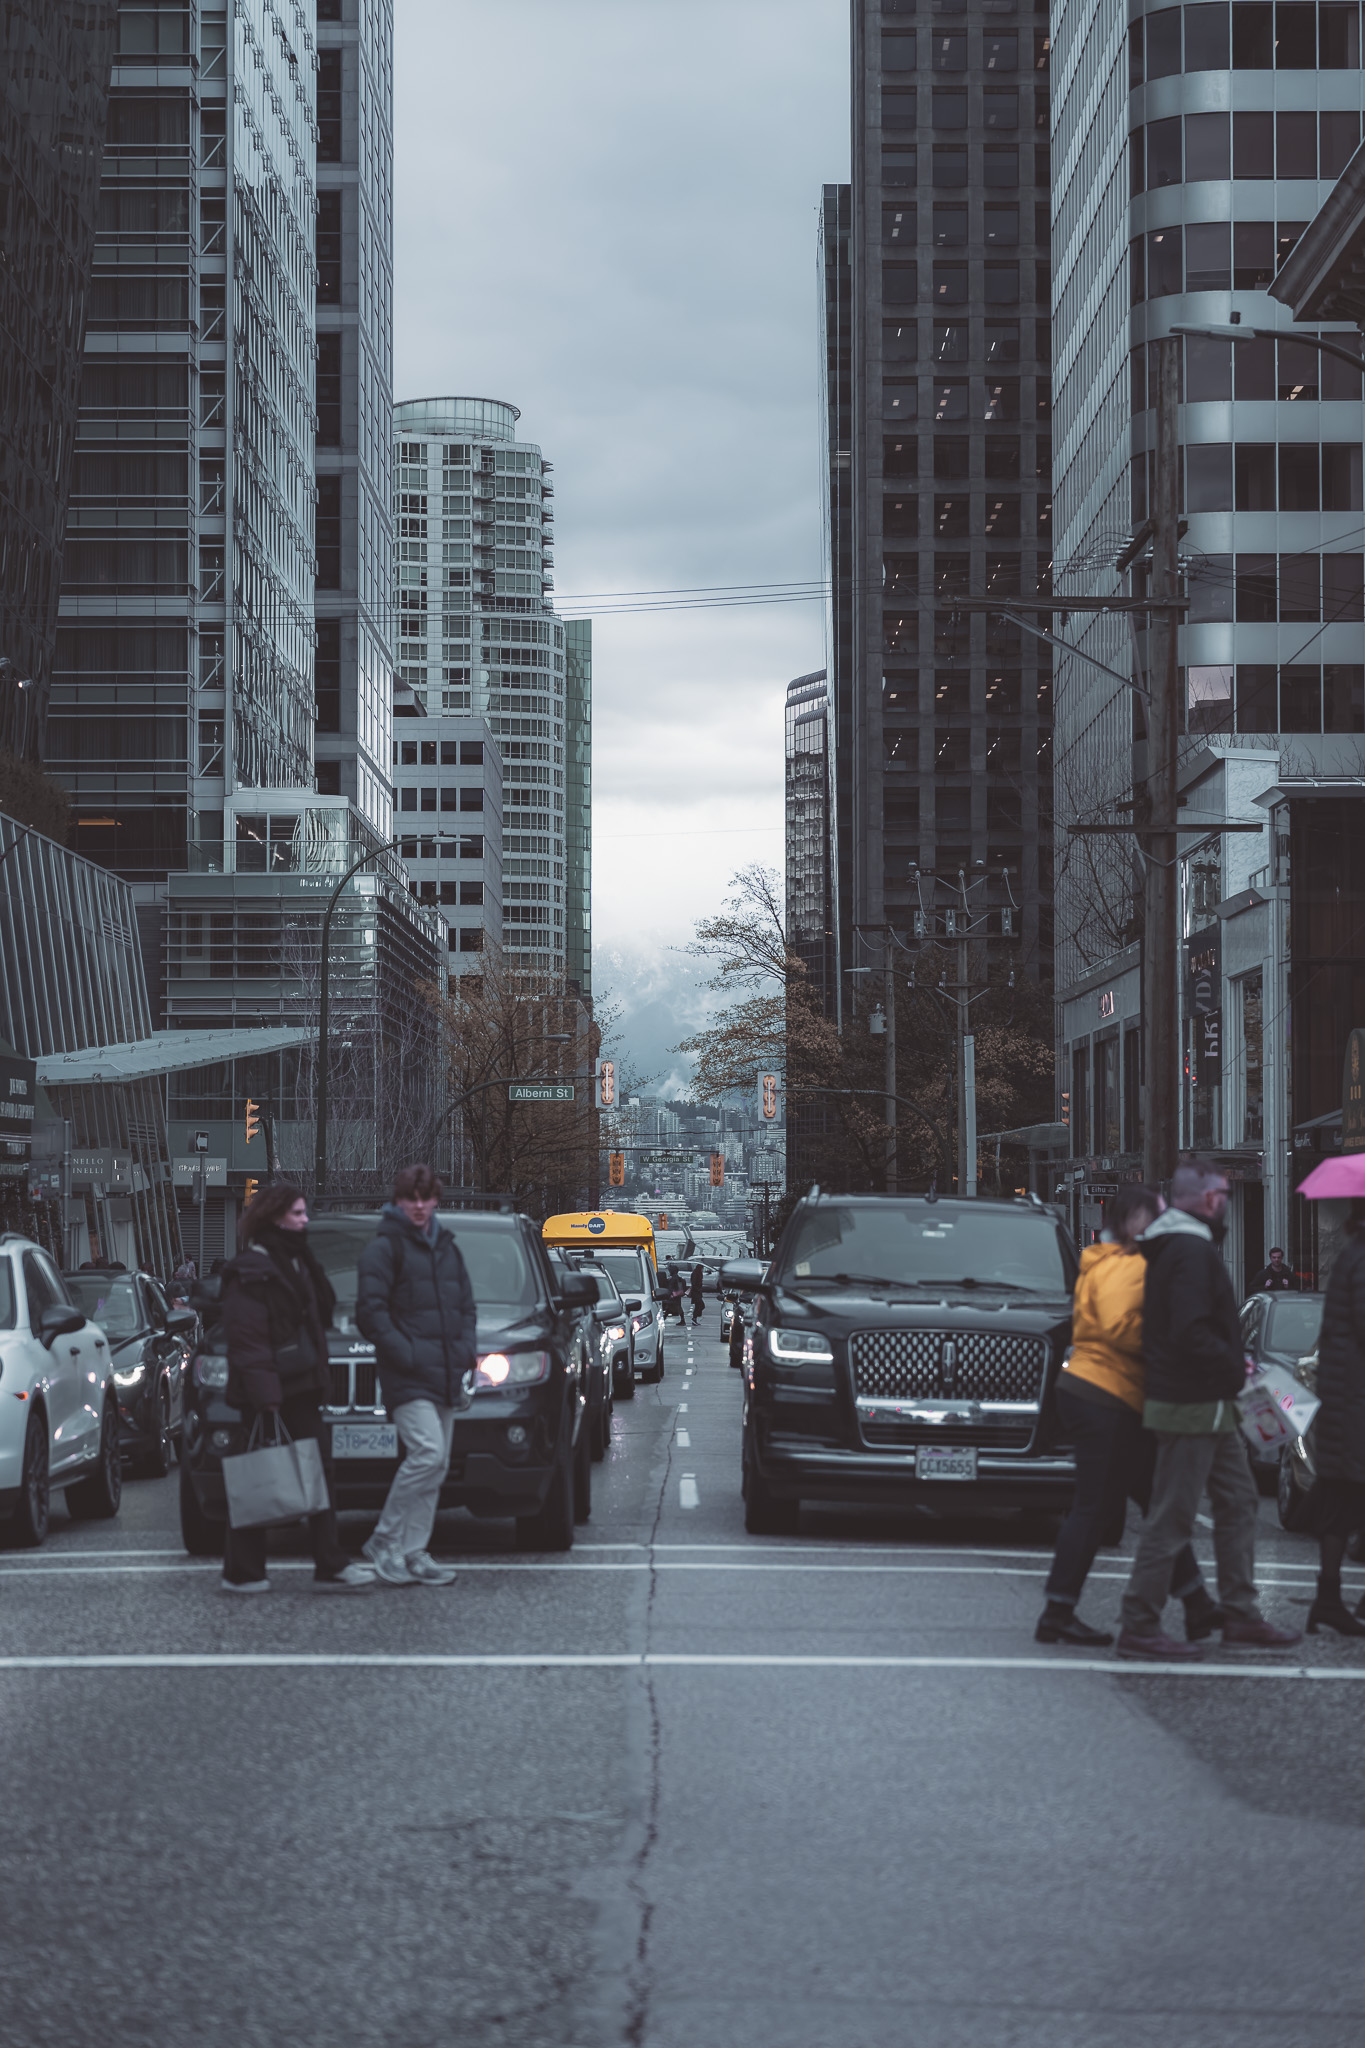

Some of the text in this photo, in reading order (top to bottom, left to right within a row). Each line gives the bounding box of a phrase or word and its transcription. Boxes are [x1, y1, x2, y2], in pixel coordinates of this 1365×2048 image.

[515, 1088, 569, 1098] Alberni St
[348, 1342, 376, 1353] Jee
